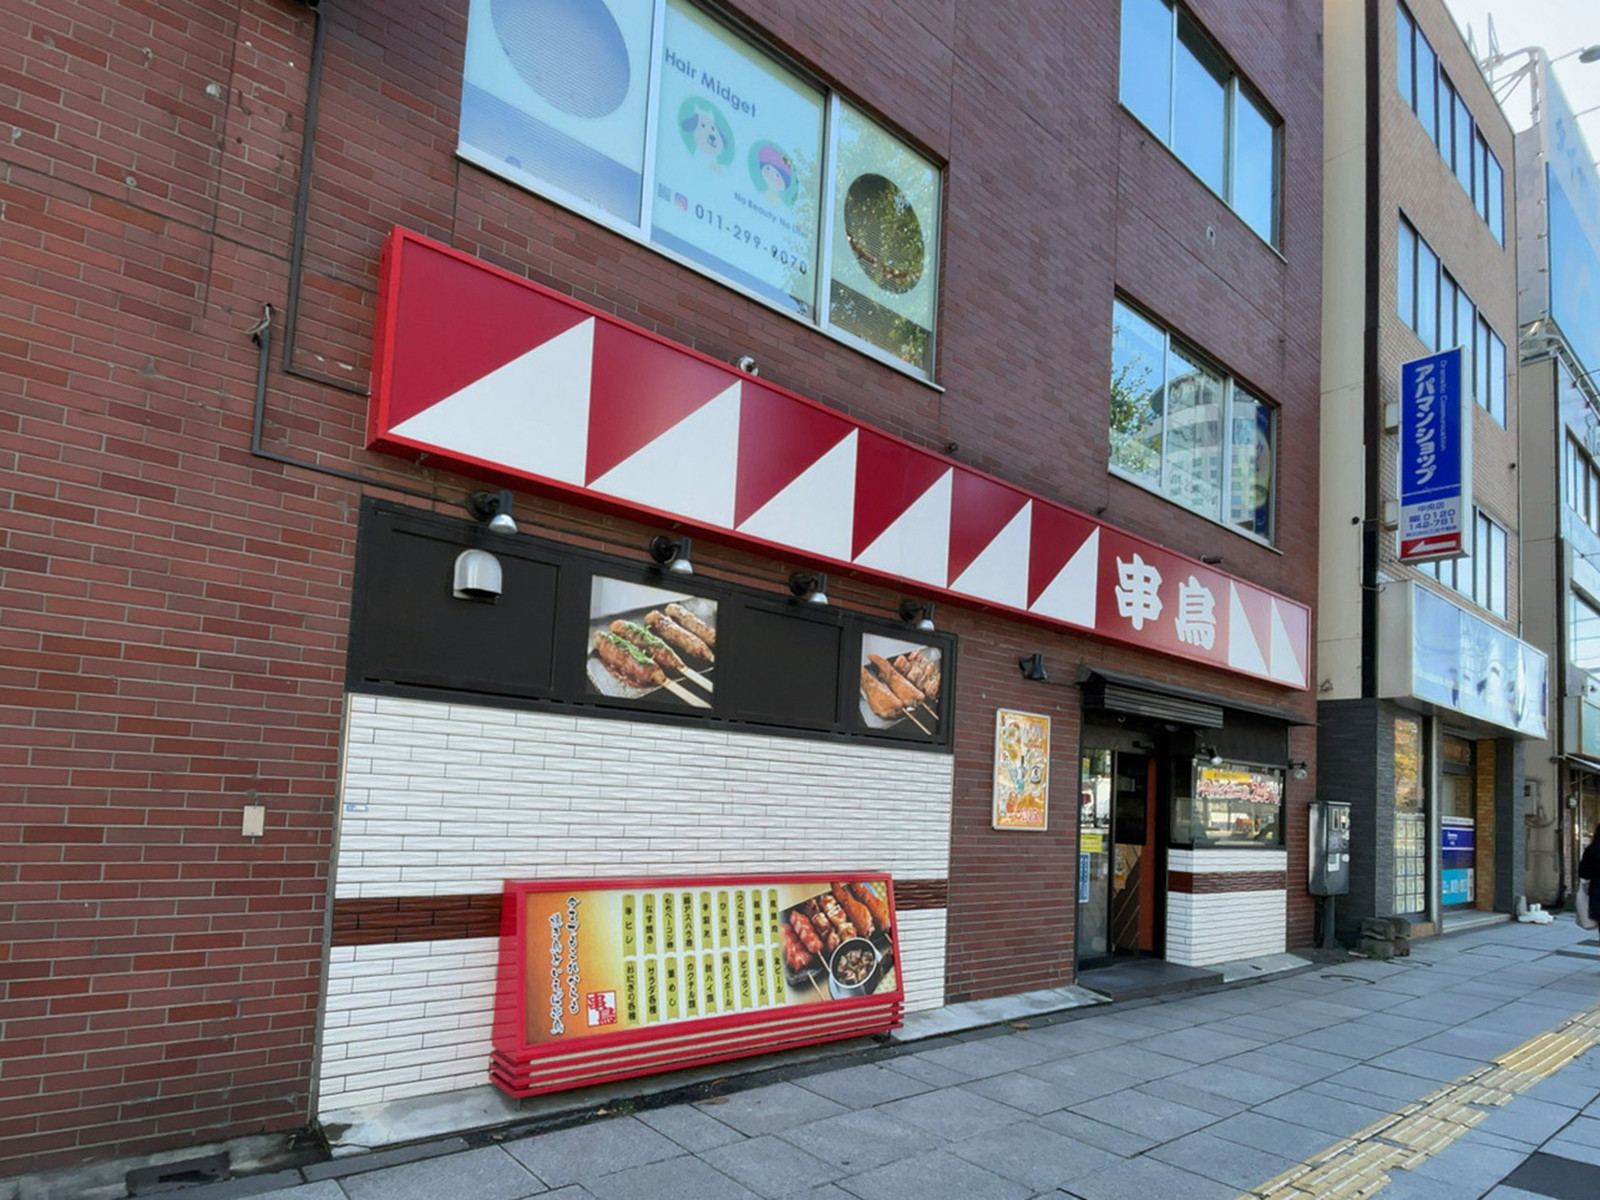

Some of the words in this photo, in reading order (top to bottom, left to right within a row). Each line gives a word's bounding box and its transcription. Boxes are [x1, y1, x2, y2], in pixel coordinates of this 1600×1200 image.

[664, 47, 697, 79] Hair
[701, 70, 757, 118] Midget
[694, 203, 808, 276] 011-299-9070
[733, 191, 747, 206] No
[747, 199, 777, 223] Beauty
[1415, 363, 1437, 485] アパマンショップ
[1417, 501, 1445, 512] 中央店
[1423, 508, 1456, 521] 0120
[1115, 552, 1217, 651] 串鳥
